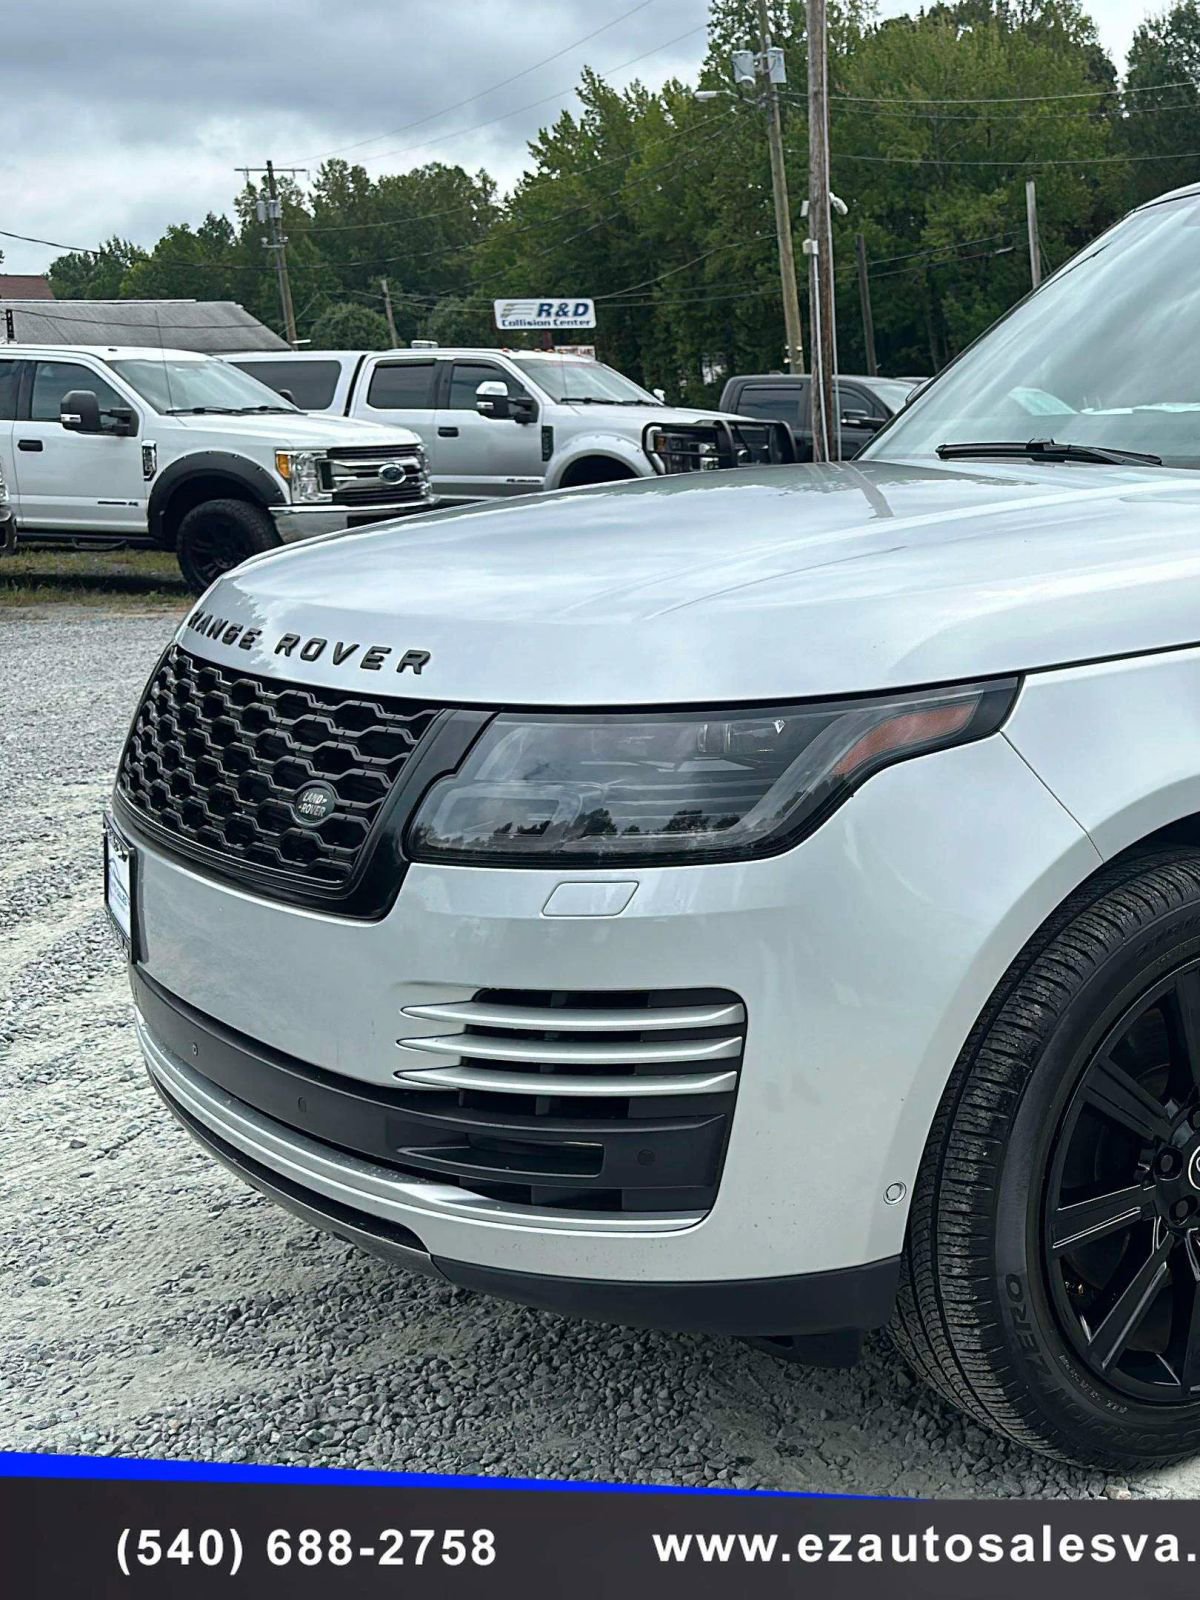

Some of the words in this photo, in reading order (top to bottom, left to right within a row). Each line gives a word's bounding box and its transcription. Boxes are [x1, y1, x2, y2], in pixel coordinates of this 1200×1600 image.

[537, 302, 590, 318] R&D
[502, 318, 551, 328] Collision
[553, 318, 592, 327] Center
[187, 610, 263, 651] RANGE
[273, 632, 432, 675] ROVER
[302, 791, 325, 806] LAND
[299, 803, 327, 818] ROVER
[1004, 1273, 1053, 1377] ZERO
